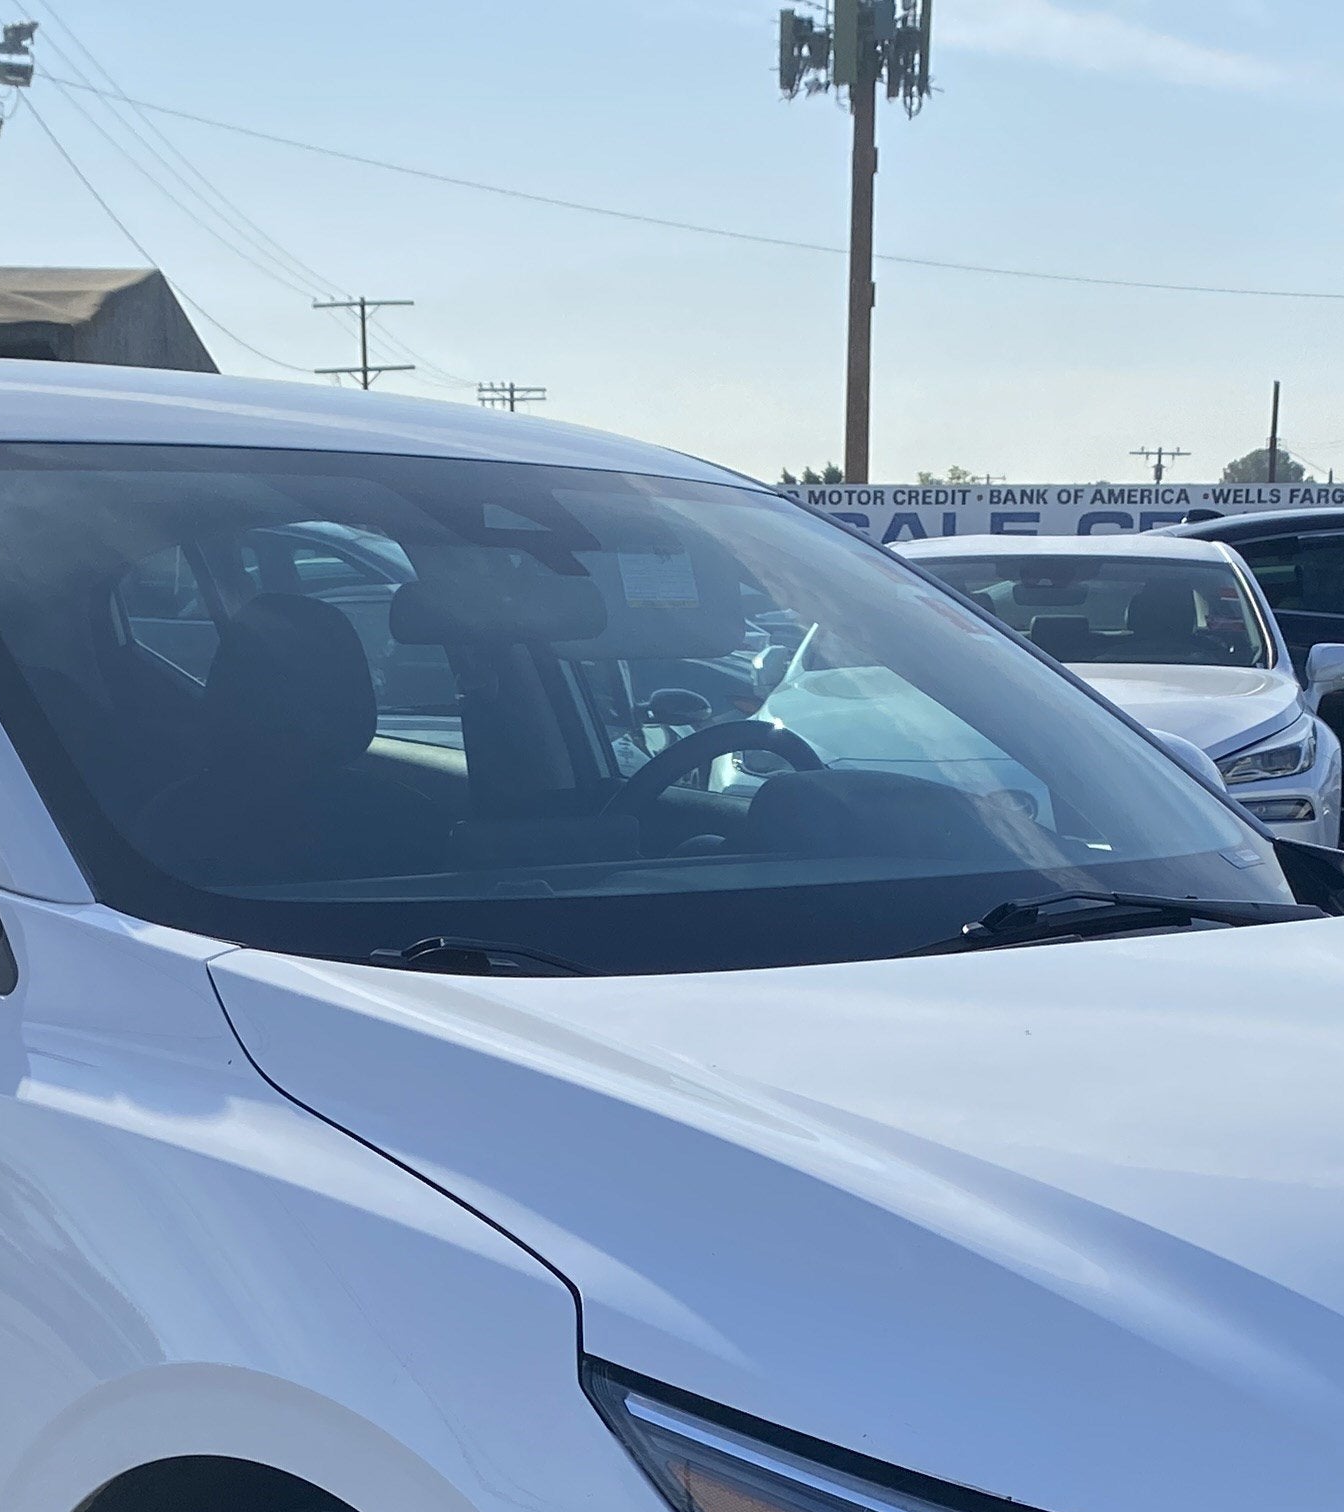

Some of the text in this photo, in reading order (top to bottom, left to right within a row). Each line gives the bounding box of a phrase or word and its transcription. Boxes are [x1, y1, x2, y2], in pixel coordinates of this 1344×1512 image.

[808, 489, 885, 506] MOTOR
[892, 489, 971, 506] CREDIT
[989, 489, 1048, 505] BANK
[1057, 488, 1085, 505] OF
[1090, 488, 1191, 505] AMERICA
[1211, 487, 1281, 505] WELLS
